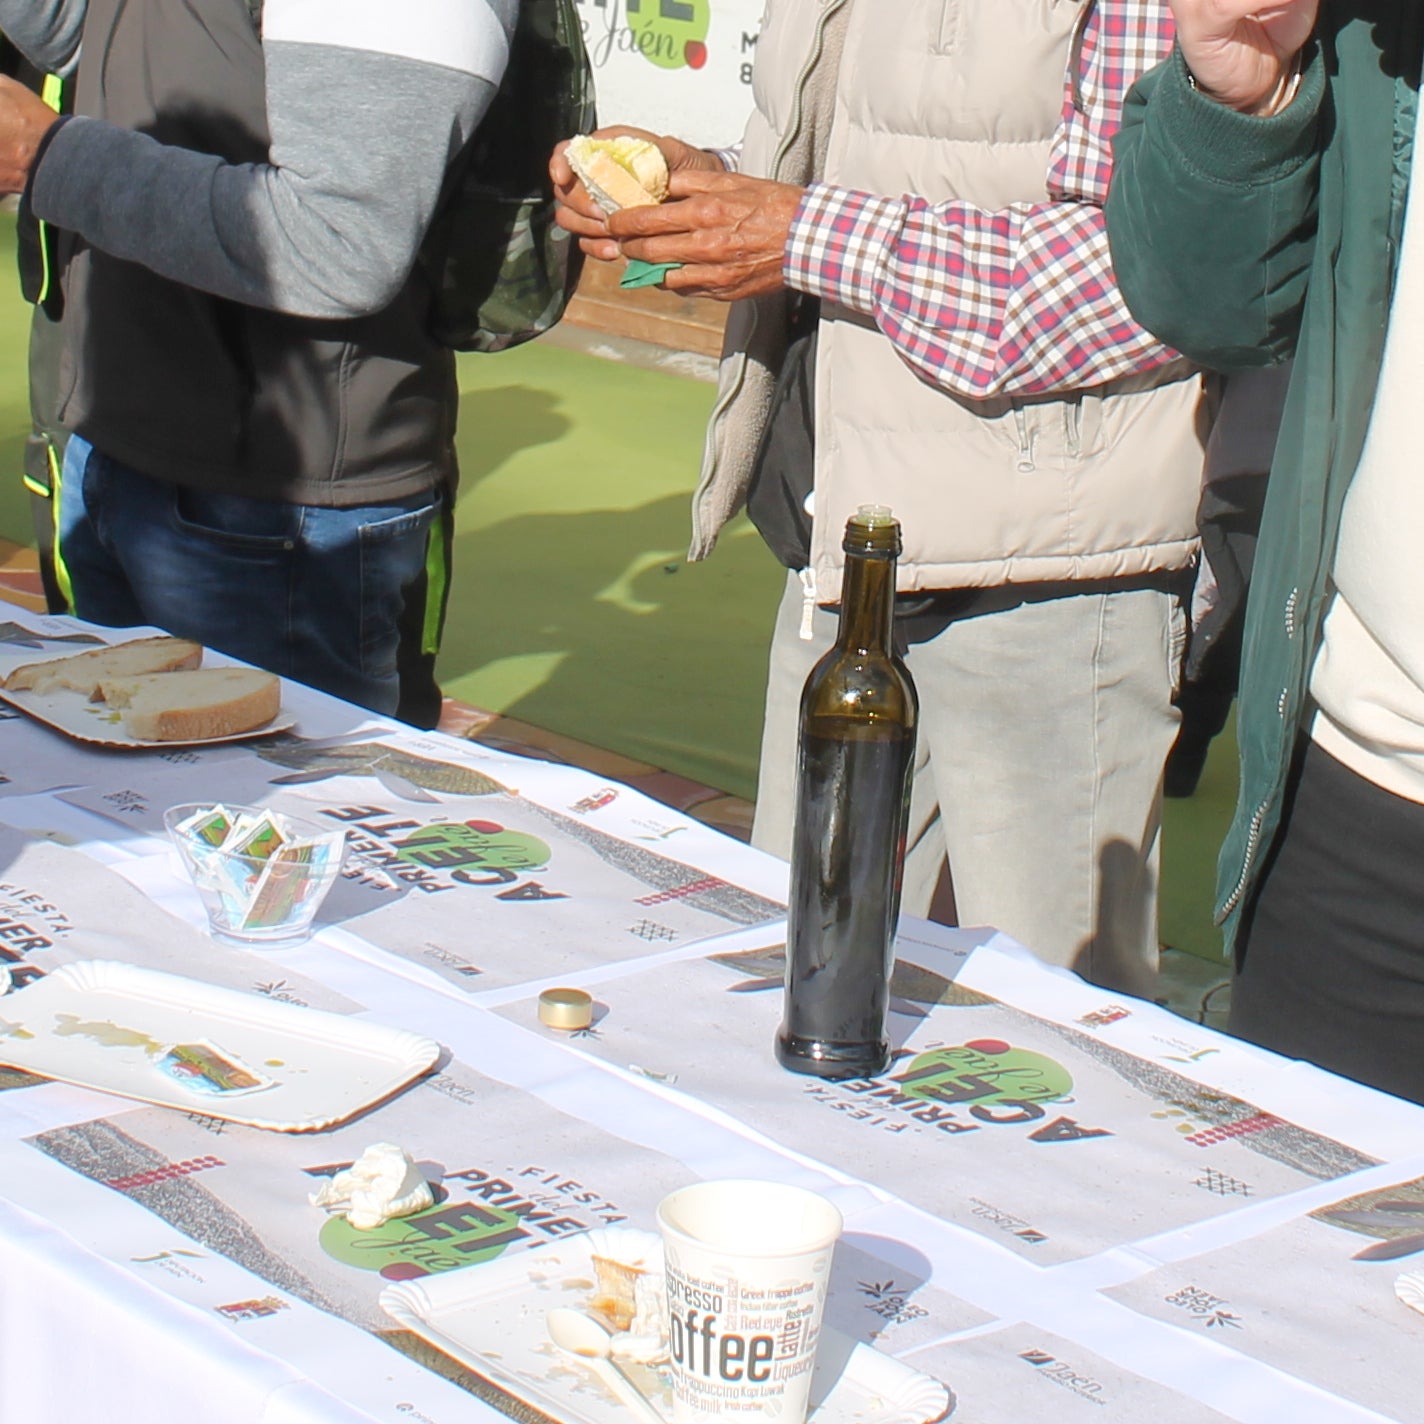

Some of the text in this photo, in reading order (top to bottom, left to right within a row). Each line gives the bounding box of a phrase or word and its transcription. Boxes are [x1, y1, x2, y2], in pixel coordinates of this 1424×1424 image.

[317, 805, 573, 902] ACEITE
[803, 1083, 909, 1134] FIESTA
[443, 1168, 592, 1240] PRIME
[519, 1166, 629, 1225] FIESTA
[774, 1319, 802, 1361] Latte
